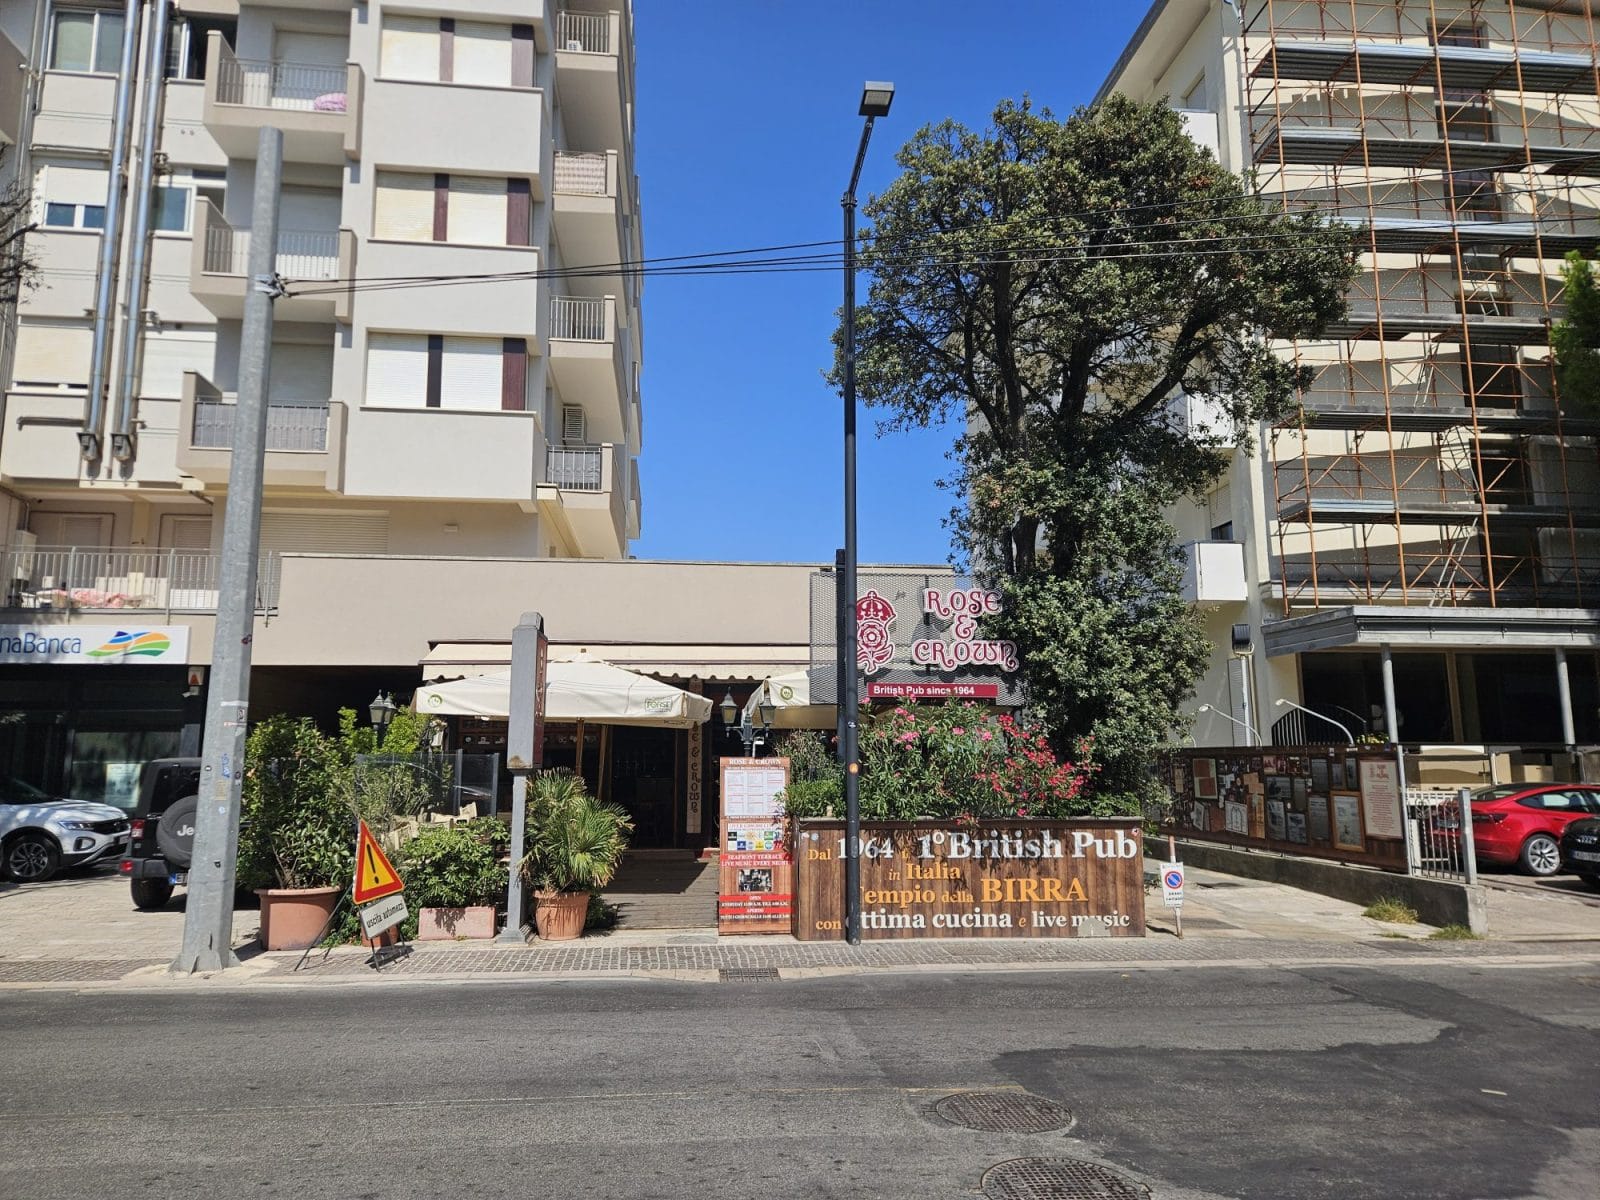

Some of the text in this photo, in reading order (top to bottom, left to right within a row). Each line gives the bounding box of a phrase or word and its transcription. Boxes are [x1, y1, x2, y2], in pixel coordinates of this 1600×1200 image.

[924, 588, 1002, 617] ROSE
[953, 614, 976, 639] &
[0, 632, 81, 654] naBanca
[913, 639, 1018, 671] CROWN
[873, 685, 975, 695] British Pub since 1964
[808, 849, 831, 860] Dal
[837, 837, 895, 859] 164
[947, 828, 1064, 859] British
[1071, 829, 1138, 859] Pub
[888, 861, 961, 881] in Italia
[860, 877, 1088, 909] empio della BIRRA
[366, 913, 383, 928] uscita
[815, 919, 842, 930] con
[845, 907, 927, 930] ttima
[932, 907, 1013, 929] cucina
[1018, 917, 1026, 928] e
[1032, 911, 1067, 928] live
